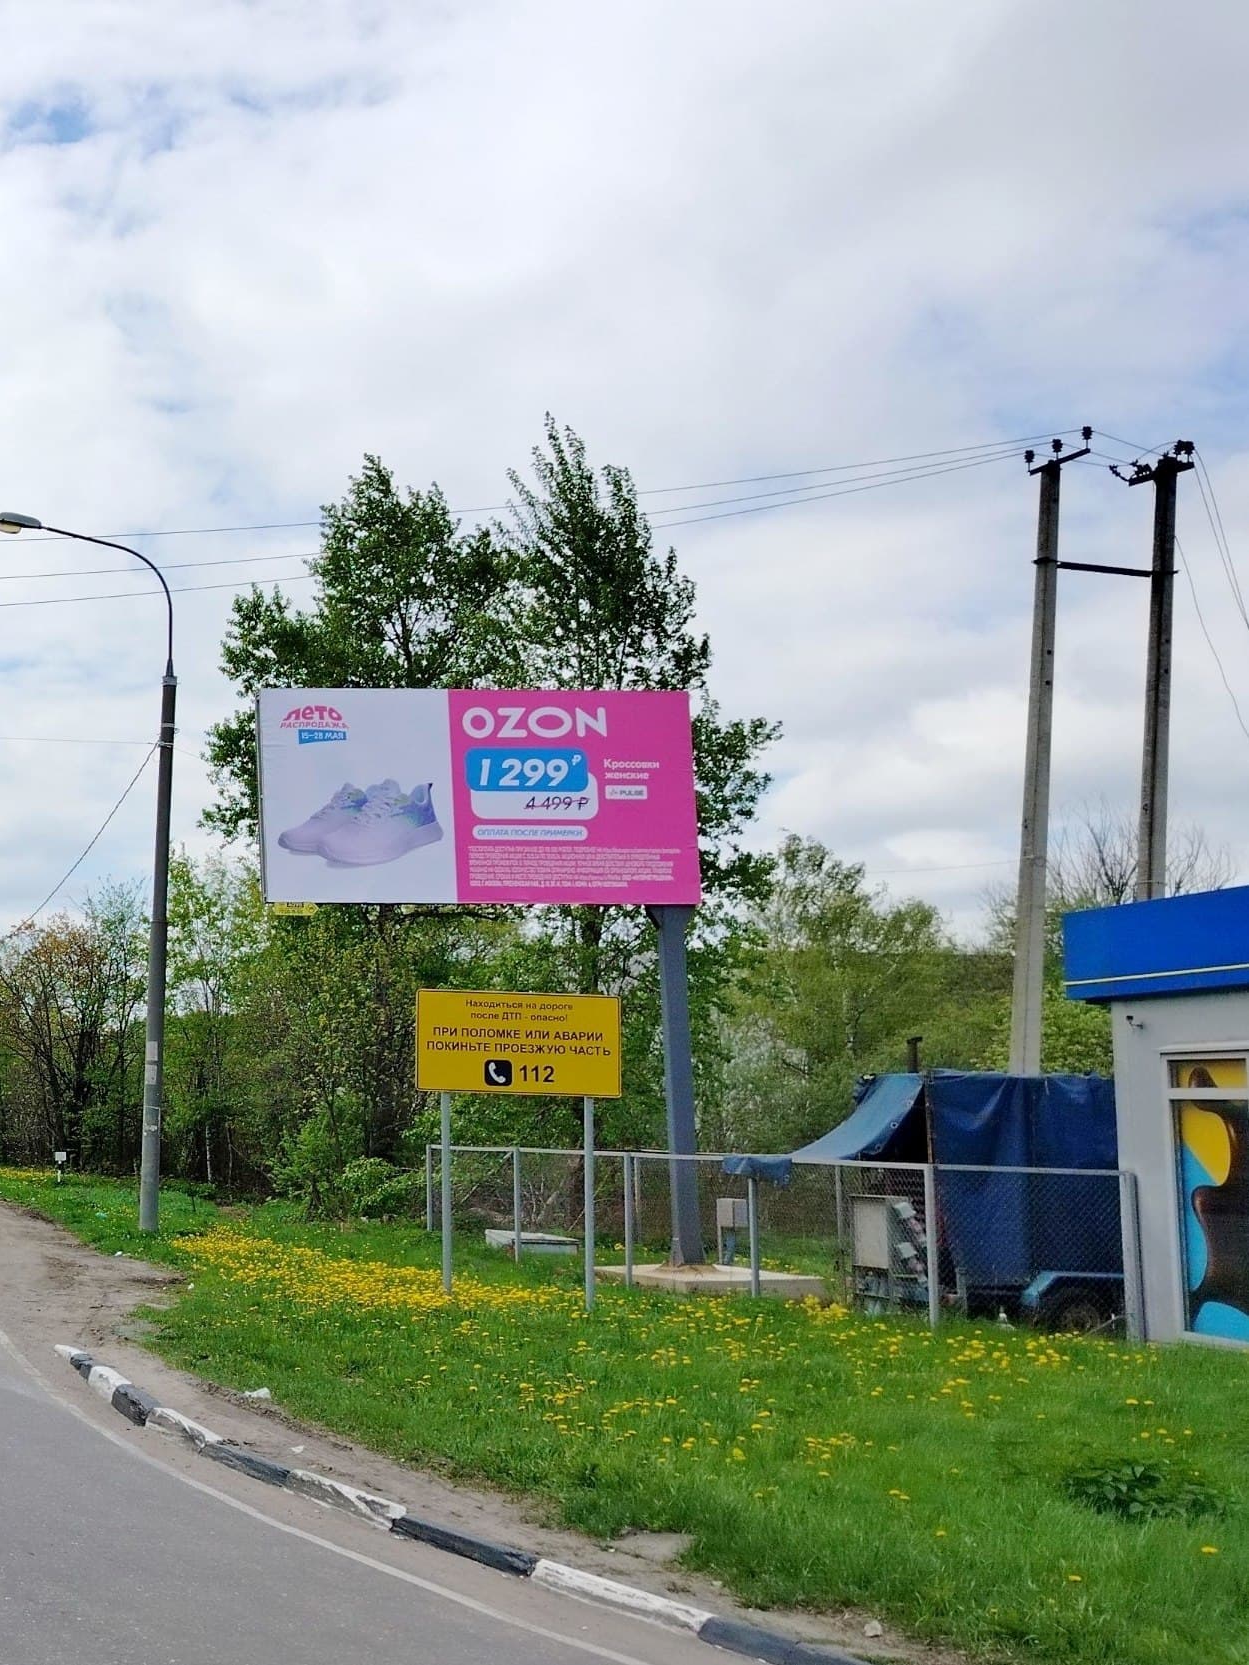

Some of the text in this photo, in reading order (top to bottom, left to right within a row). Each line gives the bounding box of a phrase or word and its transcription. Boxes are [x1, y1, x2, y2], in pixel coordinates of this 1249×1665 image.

[462, 706, 607, 739] OZON
[603, 759, 660, 769] Кроссовки
[465, 999, 523, 1009] Находиться
[539, 1003, 573, 1011] дороге
[470, 1012, 499, 1020] после
[501, 1011, 522, 1021] ДТП
[530, 1014, 568, 1022] опасно!
[433, 1026, 603, 1041] ПРИ ПОЛОМКЕ ИЛИ АВАРИИ
[427, 1040, 611, 1056] ПОКИНЬТЕ ПРОЕЗЖУЮ ЧАСТЬ
[519, 1065, 555, 1083] 112
